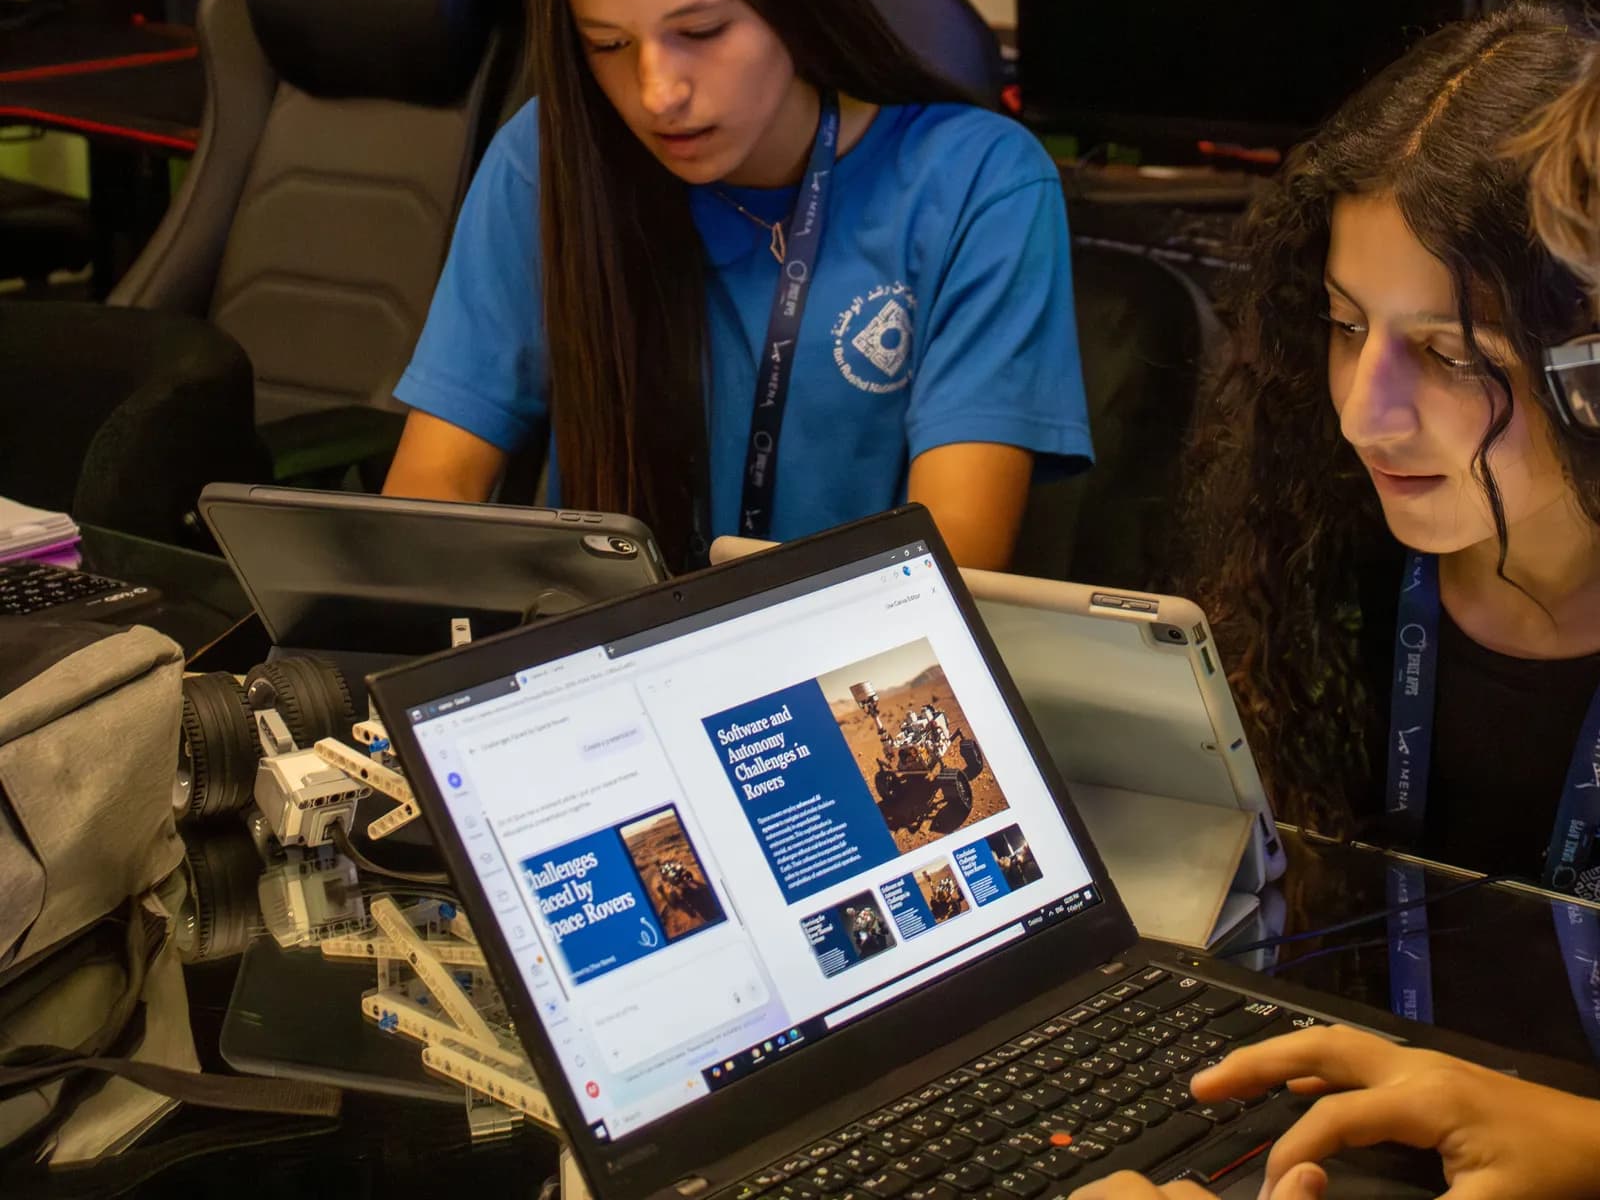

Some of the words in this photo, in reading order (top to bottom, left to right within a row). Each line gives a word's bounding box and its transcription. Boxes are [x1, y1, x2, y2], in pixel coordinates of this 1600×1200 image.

[718, 719, 769, 745] Software
[770, 705, 792, 726] and
[729, 733, 784, 765] Autonomy
[735, 747, 796, 781] Challenges
[794, 743, 810, 758] in
[743, 776, 784, 800] Rovers
[536, 883, 576, 914] aced
[569, 877, 594, 902] by
[582, 893, 635, 924] Rovers
